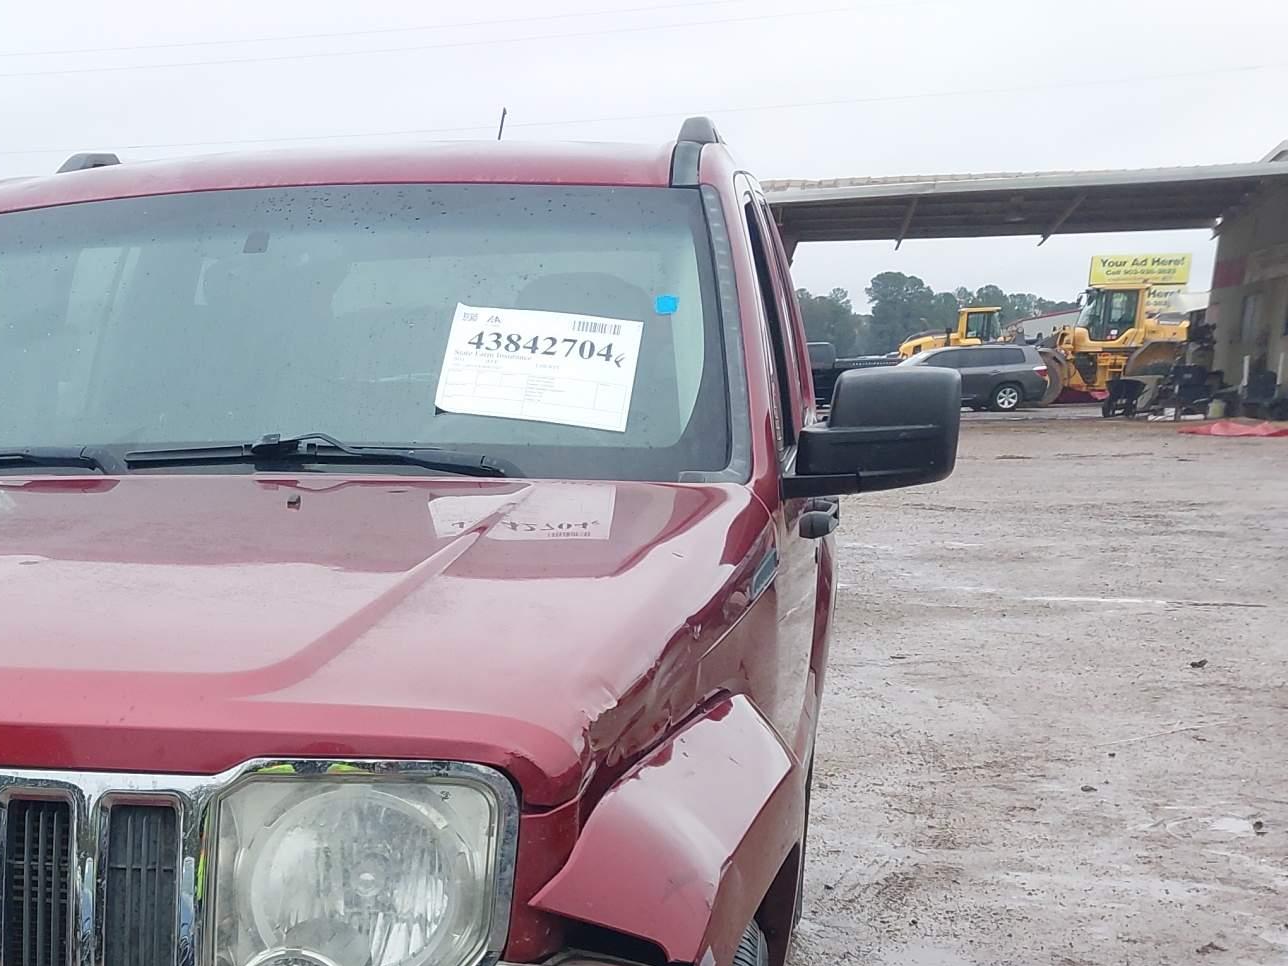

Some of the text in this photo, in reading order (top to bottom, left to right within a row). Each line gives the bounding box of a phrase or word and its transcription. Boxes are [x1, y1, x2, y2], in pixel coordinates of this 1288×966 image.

[1101, 256, 1186, 267] Your Ad Here!
[467, 331, 613, 362] 43842704
